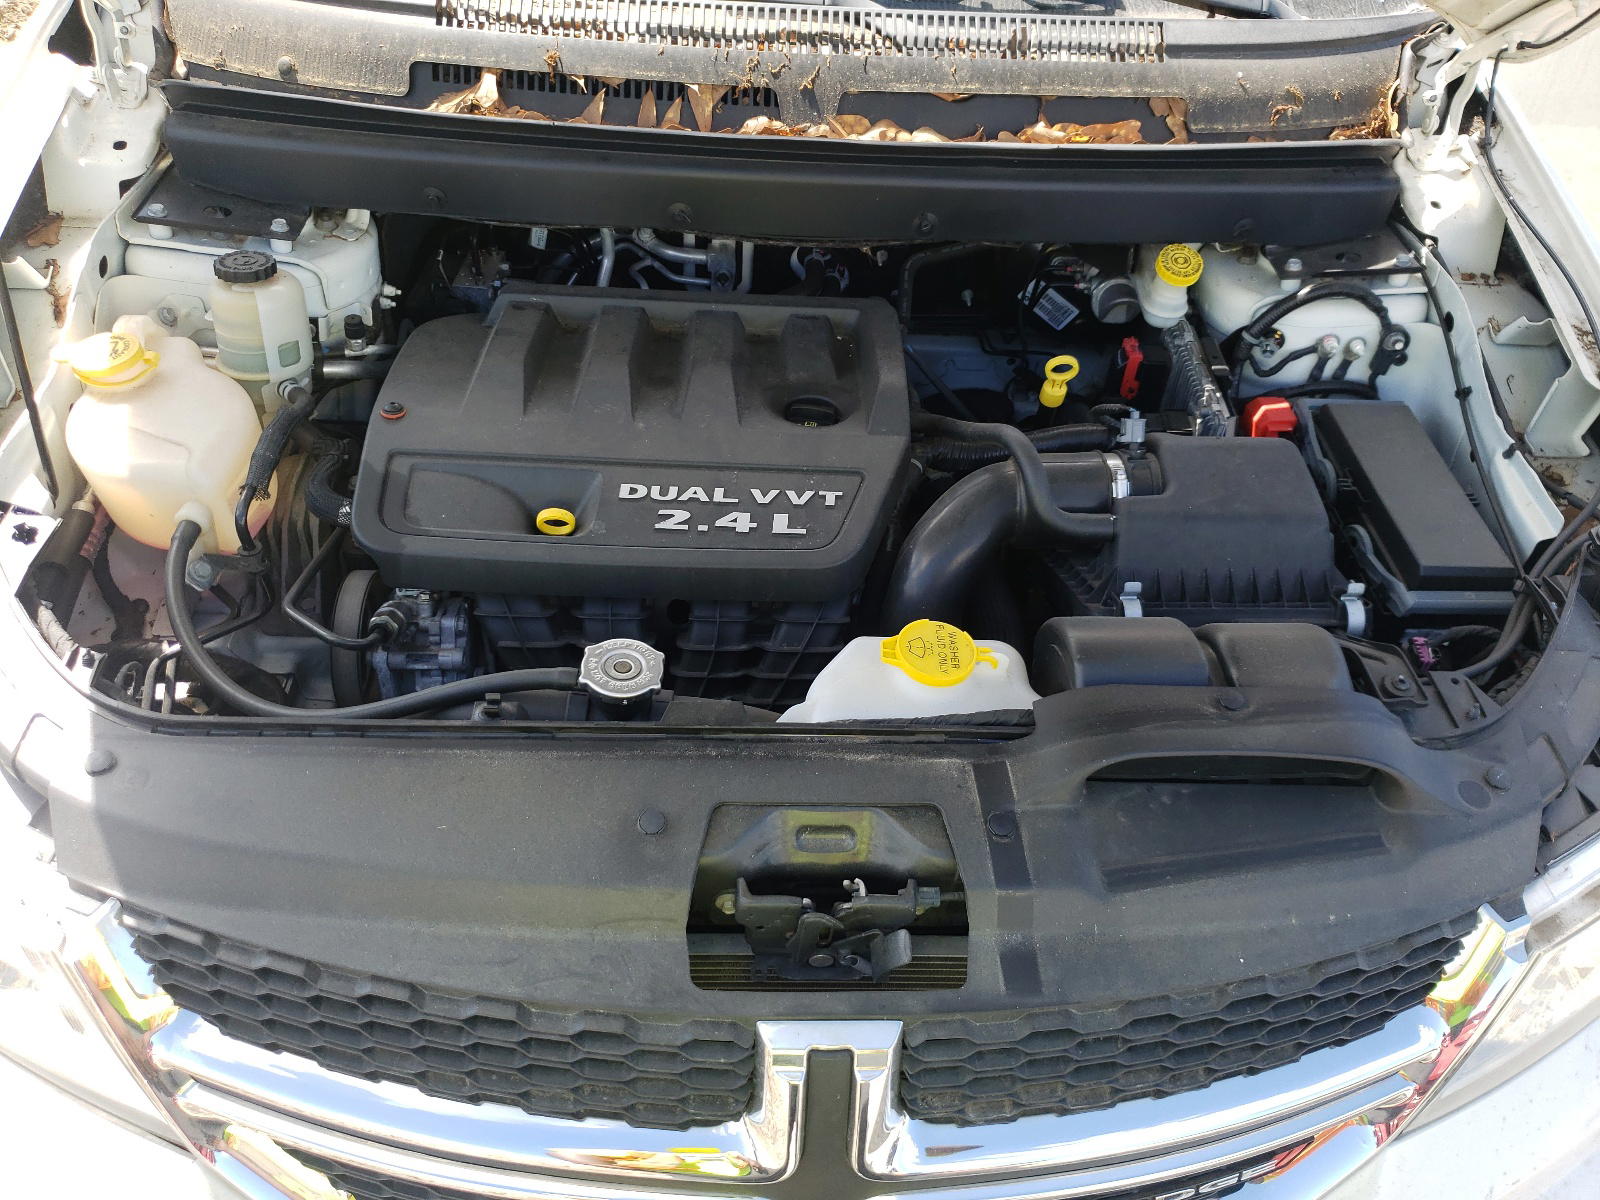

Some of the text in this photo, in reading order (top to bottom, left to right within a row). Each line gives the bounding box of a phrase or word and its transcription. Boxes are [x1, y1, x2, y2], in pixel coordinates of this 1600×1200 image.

[618, 483, 844, 506] DUAL VVT
[936, 624, 950, 675] FLUID ONLY
[948, 631, 961, 670] WASHER
